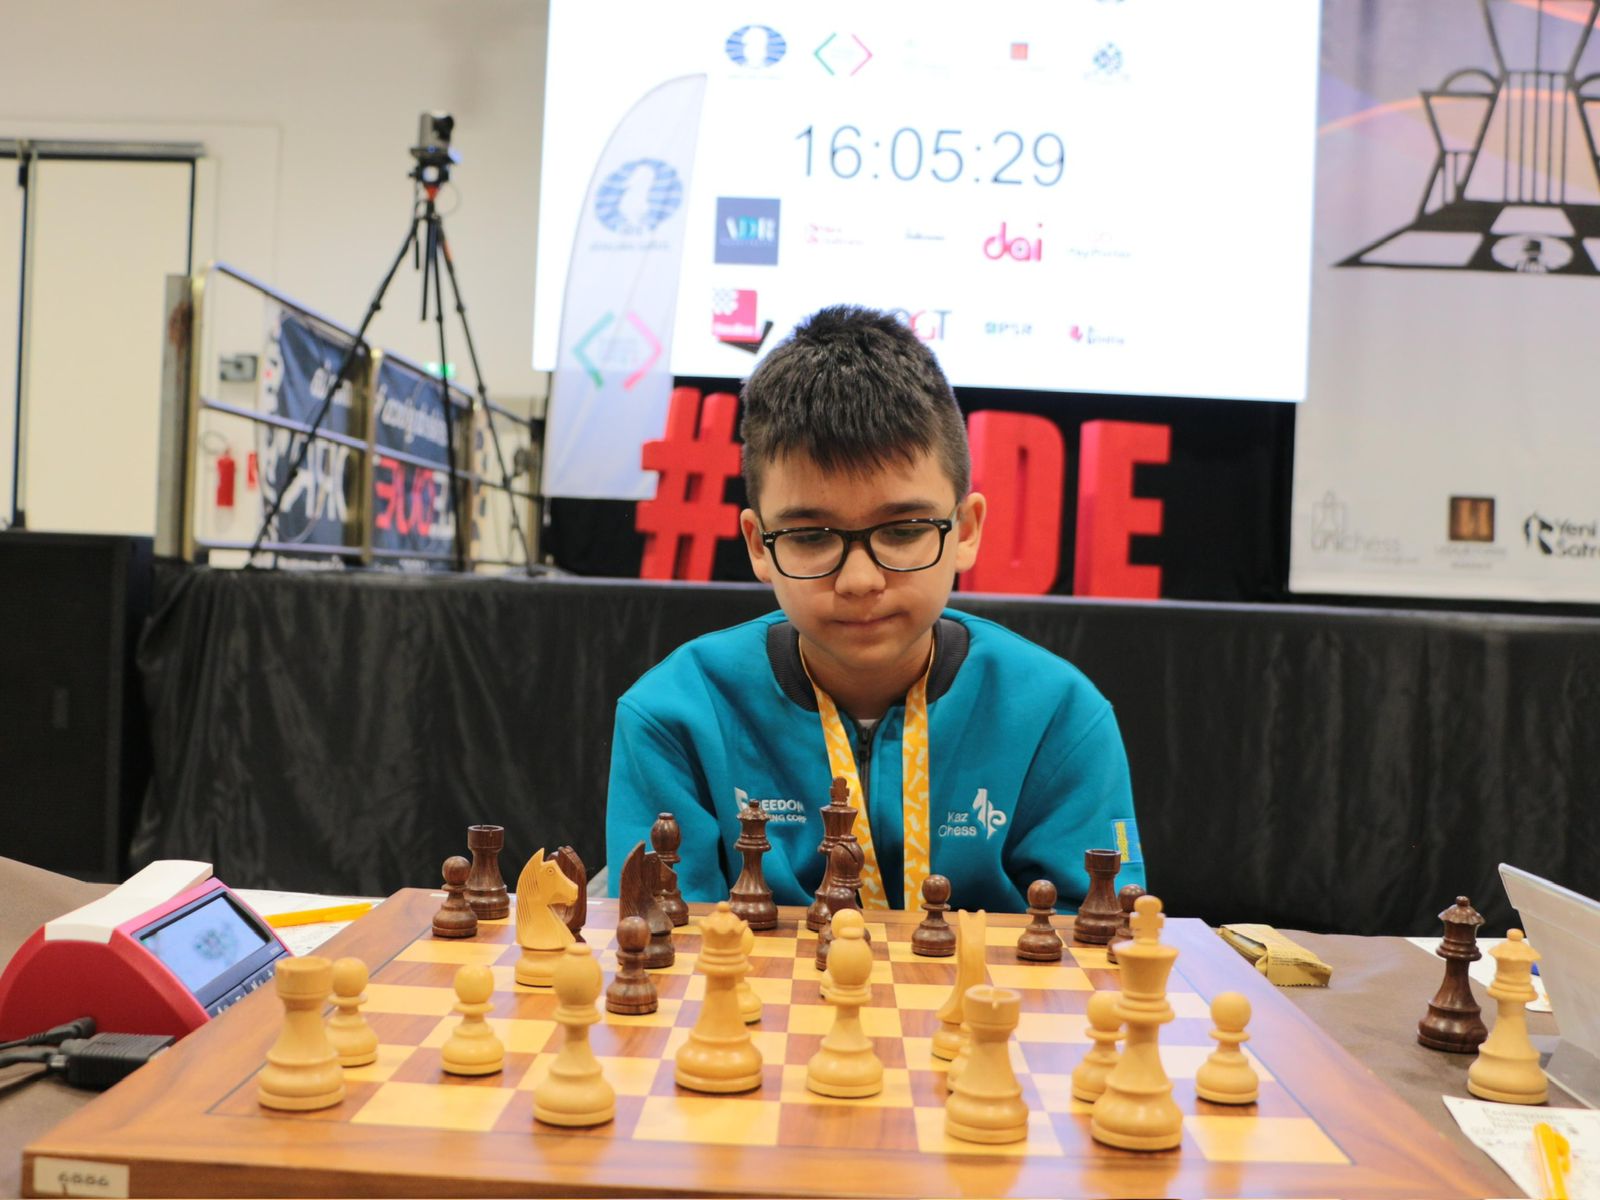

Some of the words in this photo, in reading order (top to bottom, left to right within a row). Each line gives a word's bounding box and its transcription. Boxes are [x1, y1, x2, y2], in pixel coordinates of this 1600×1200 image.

[796, 125, 1065, 187] 16:05:29
[1554, 518, 1596, 536] Yeni
[1555, 538, 1600, 558] Satr
[947, 811, 969, 823] Kaz
[938, 825, 977, 837] Chess
